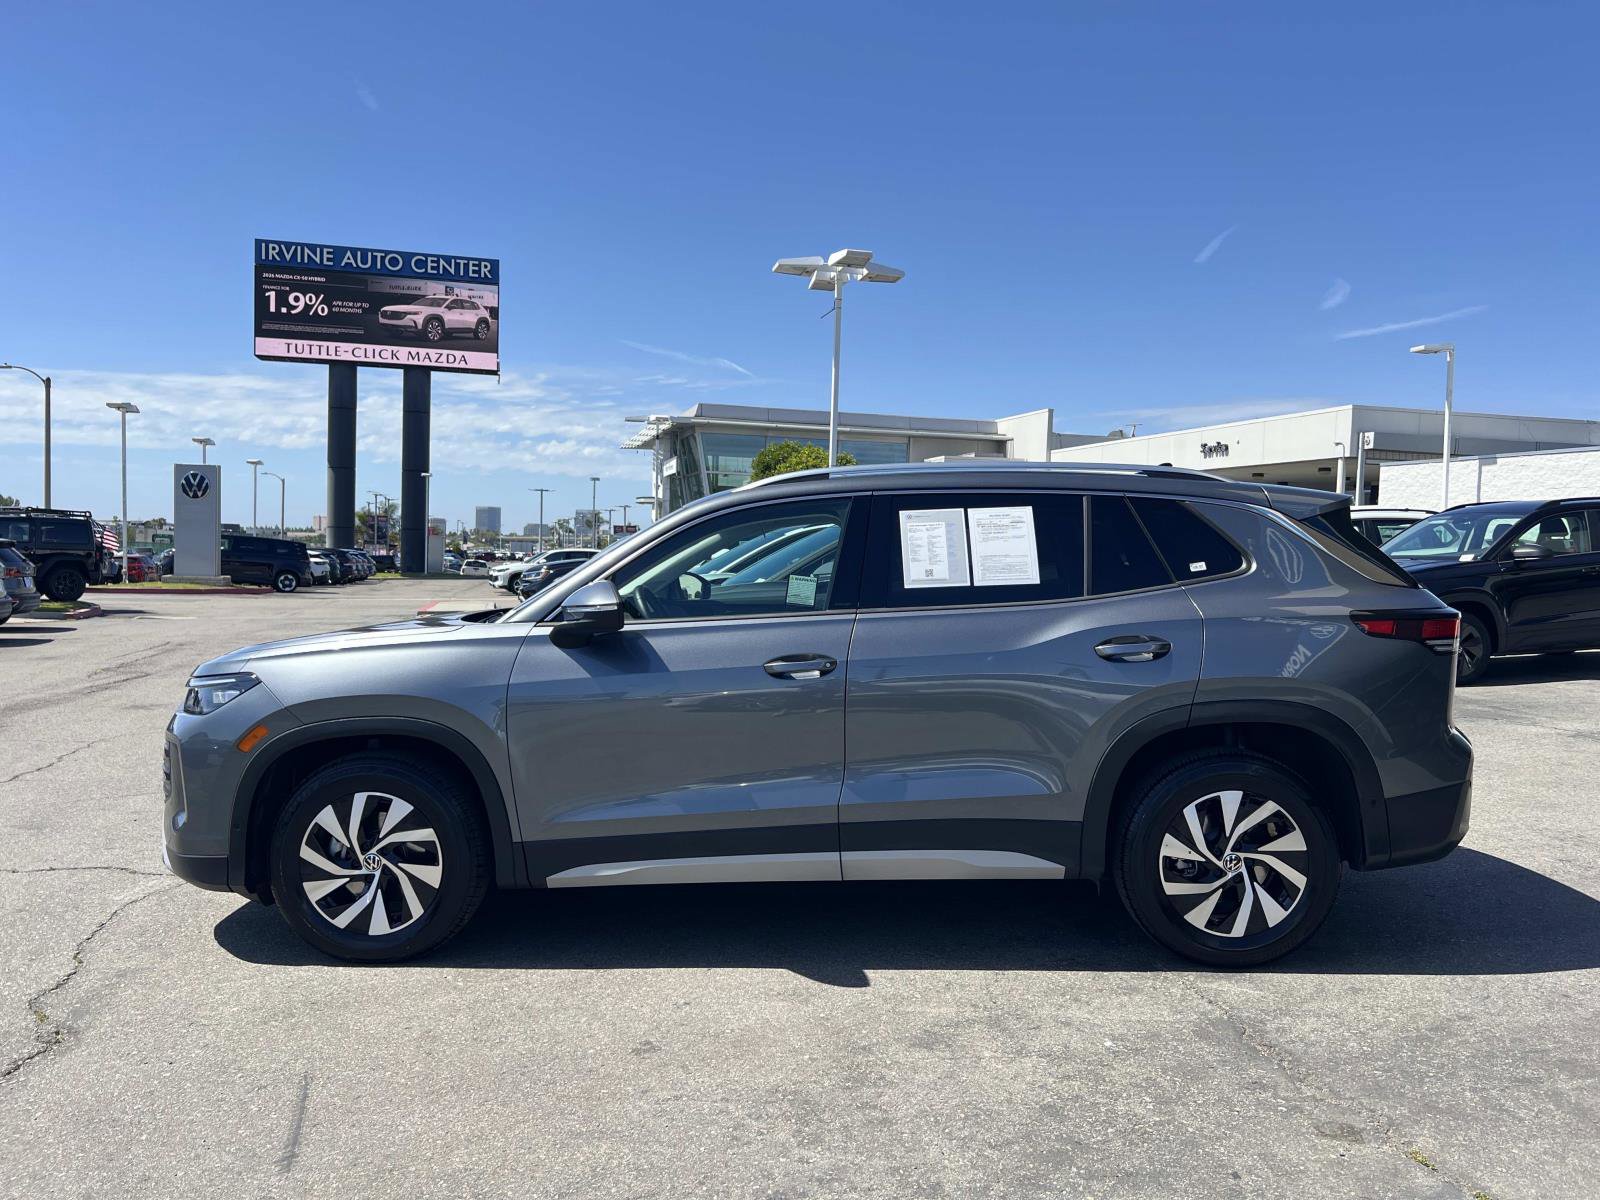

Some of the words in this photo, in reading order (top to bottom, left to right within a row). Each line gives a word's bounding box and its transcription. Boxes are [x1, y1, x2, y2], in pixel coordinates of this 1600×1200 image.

[261, 243, 335, 266] IRVINE
[341, 249, 403, 271] AUTO
[411, 255, 493, 279] CENTER
[265, 290, 329, 316] 1.9%
[284, 342, 400, 361] TUTTLE-CLICK
[407, 350, 468, 365] MAZDA
